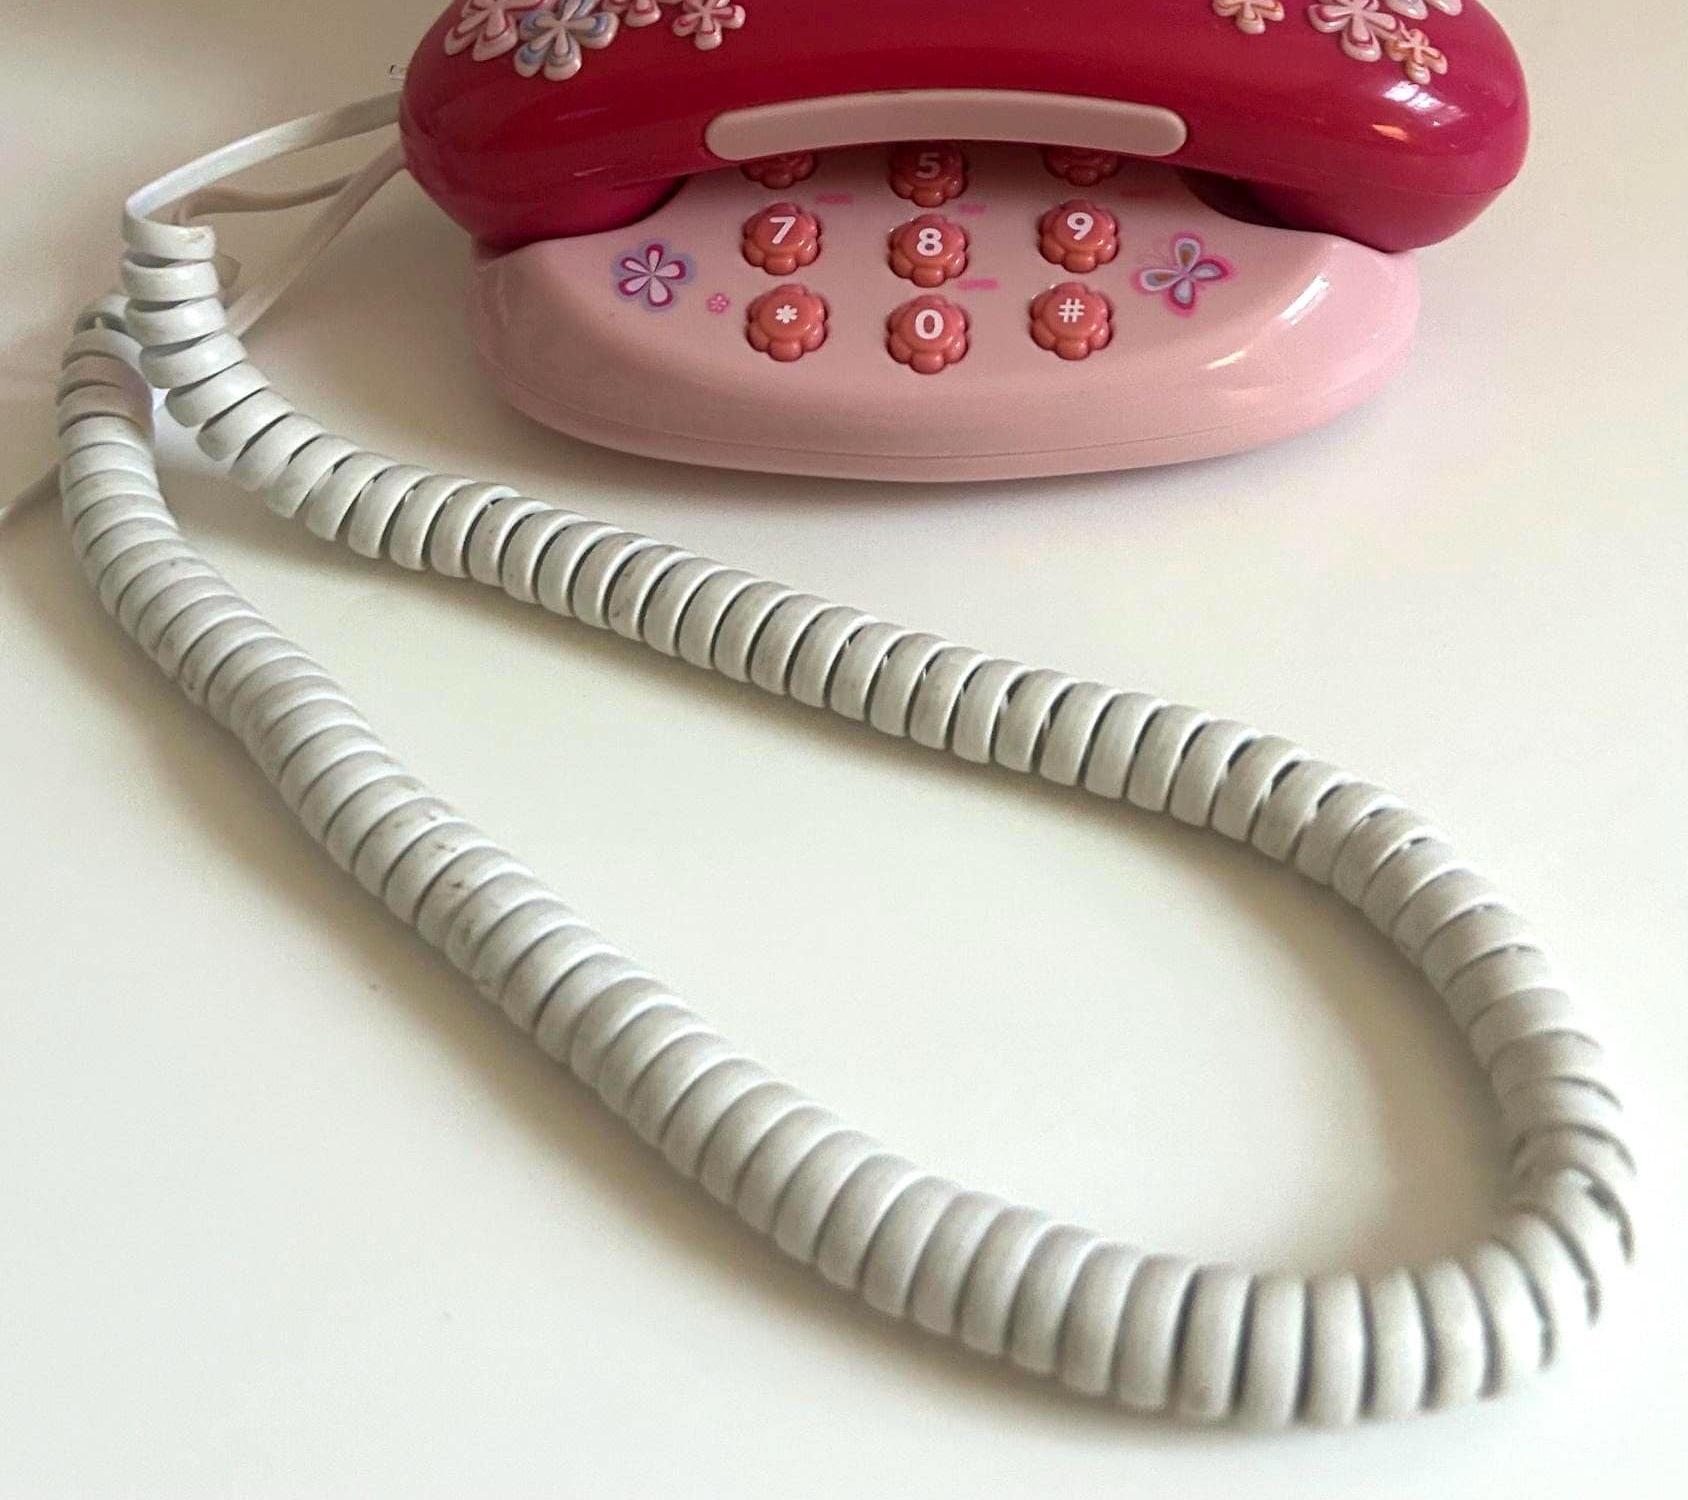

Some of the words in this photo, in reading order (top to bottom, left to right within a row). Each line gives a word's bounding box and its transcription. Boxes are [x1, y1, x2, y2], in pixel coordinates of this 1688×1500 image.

[916, 152, 941, 180] 5
[769, 215, 797, 245] 7
[1066, 212, 1095, 241] 9
[916, 227, 945, 257] 8
[914, 308, 945, 340] 0
[1057, 297, 1086, 324] #
